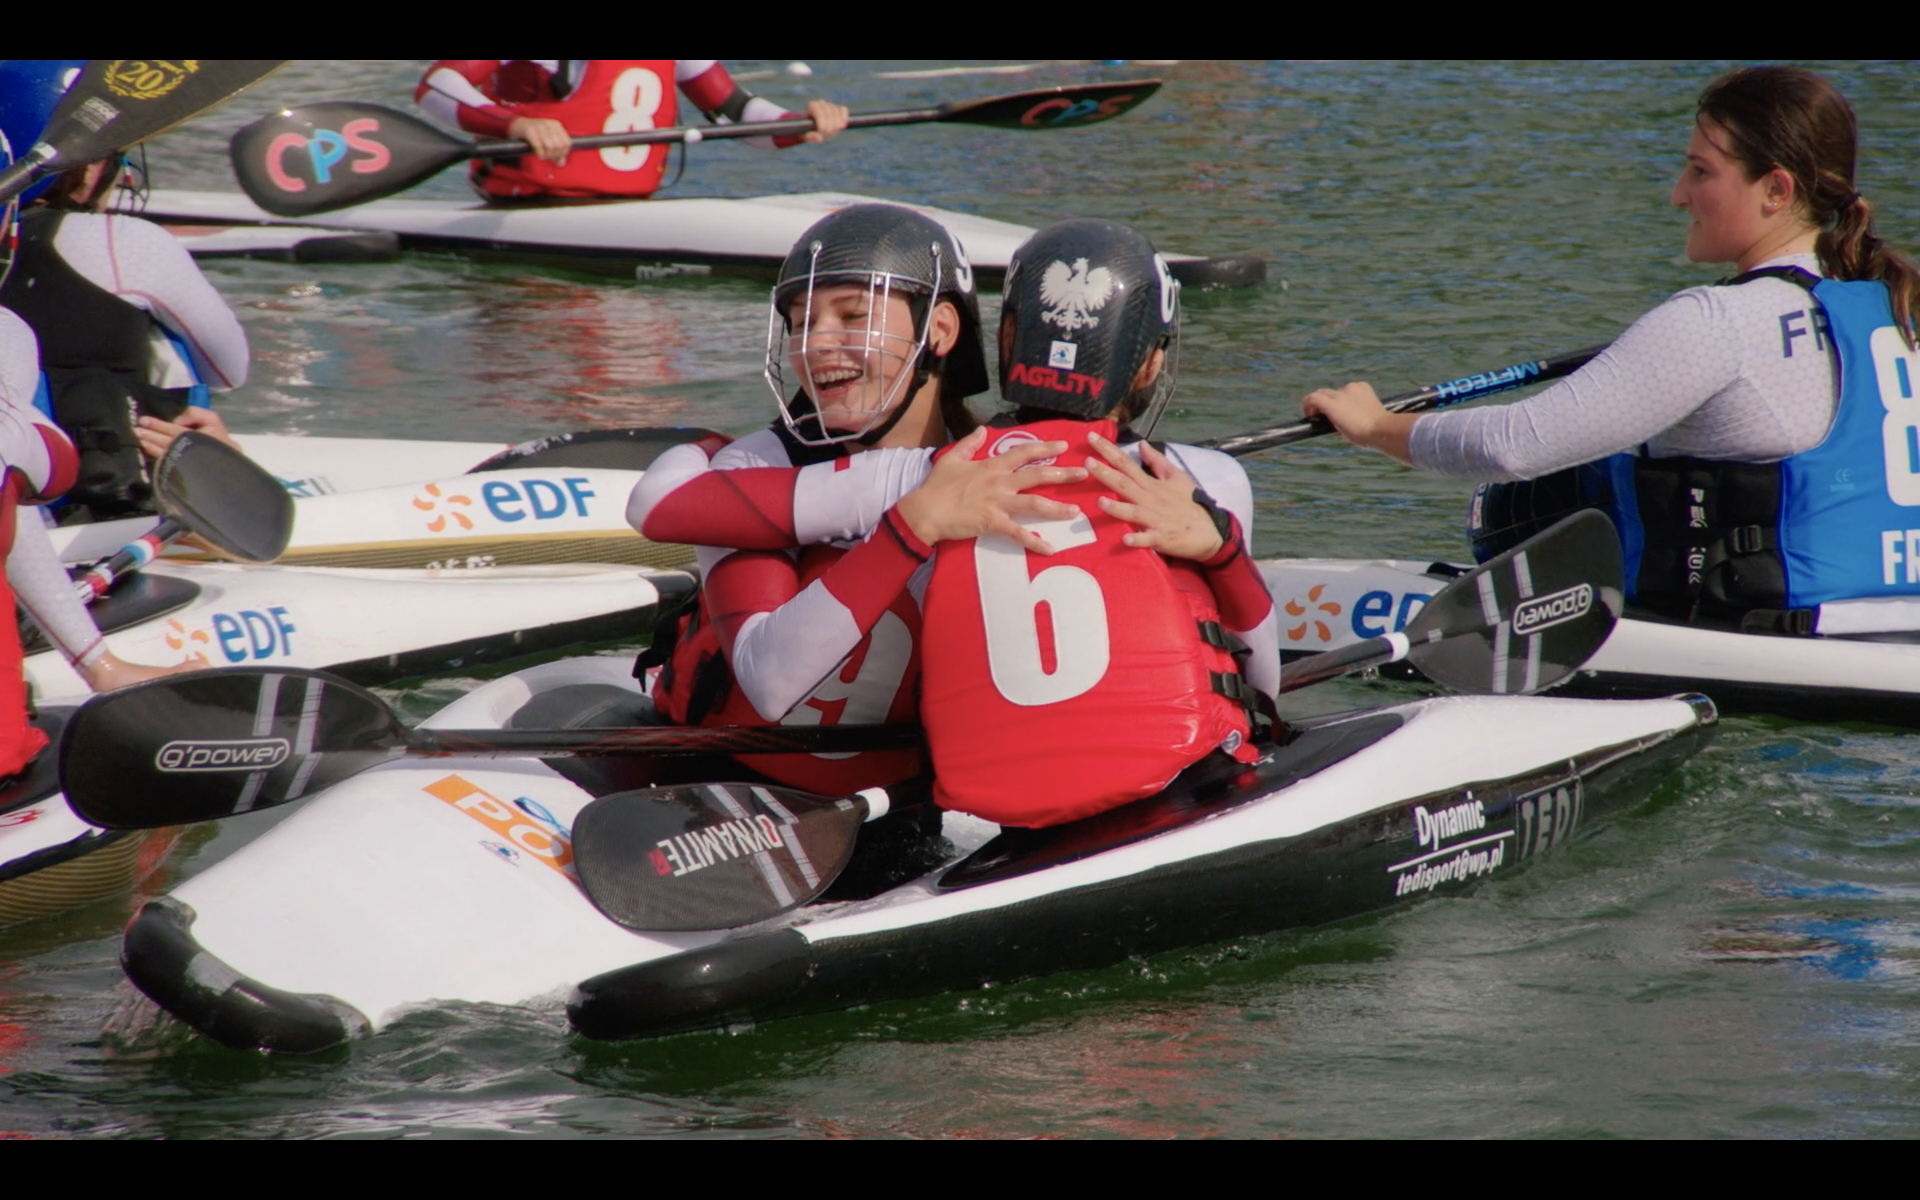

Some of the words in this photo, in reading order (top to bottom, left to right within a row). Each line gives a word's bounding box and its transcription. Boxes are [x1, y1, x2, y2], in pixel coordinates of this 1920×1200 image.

[117, 61, 164, 91] 20
[600, 67, 663, 171] 8
[1021, 95, 1134, 126] CPS
[266, 118, 391, 192] CPS
[1154, 253, 1176, 323] 6
[1009, 362, 1107, 398] AGILITY
[1437, 361, 1539, 398] MFTECH
[1870, 326, 1920, 506] 8
[974, 510, 1111, 706] 6
[656, 814, 784, 877] DYNAMITE
[1414, 790, 1486, 851] Dynamic
[1395, 839, 1505, 897] tedisport@wp.pl
